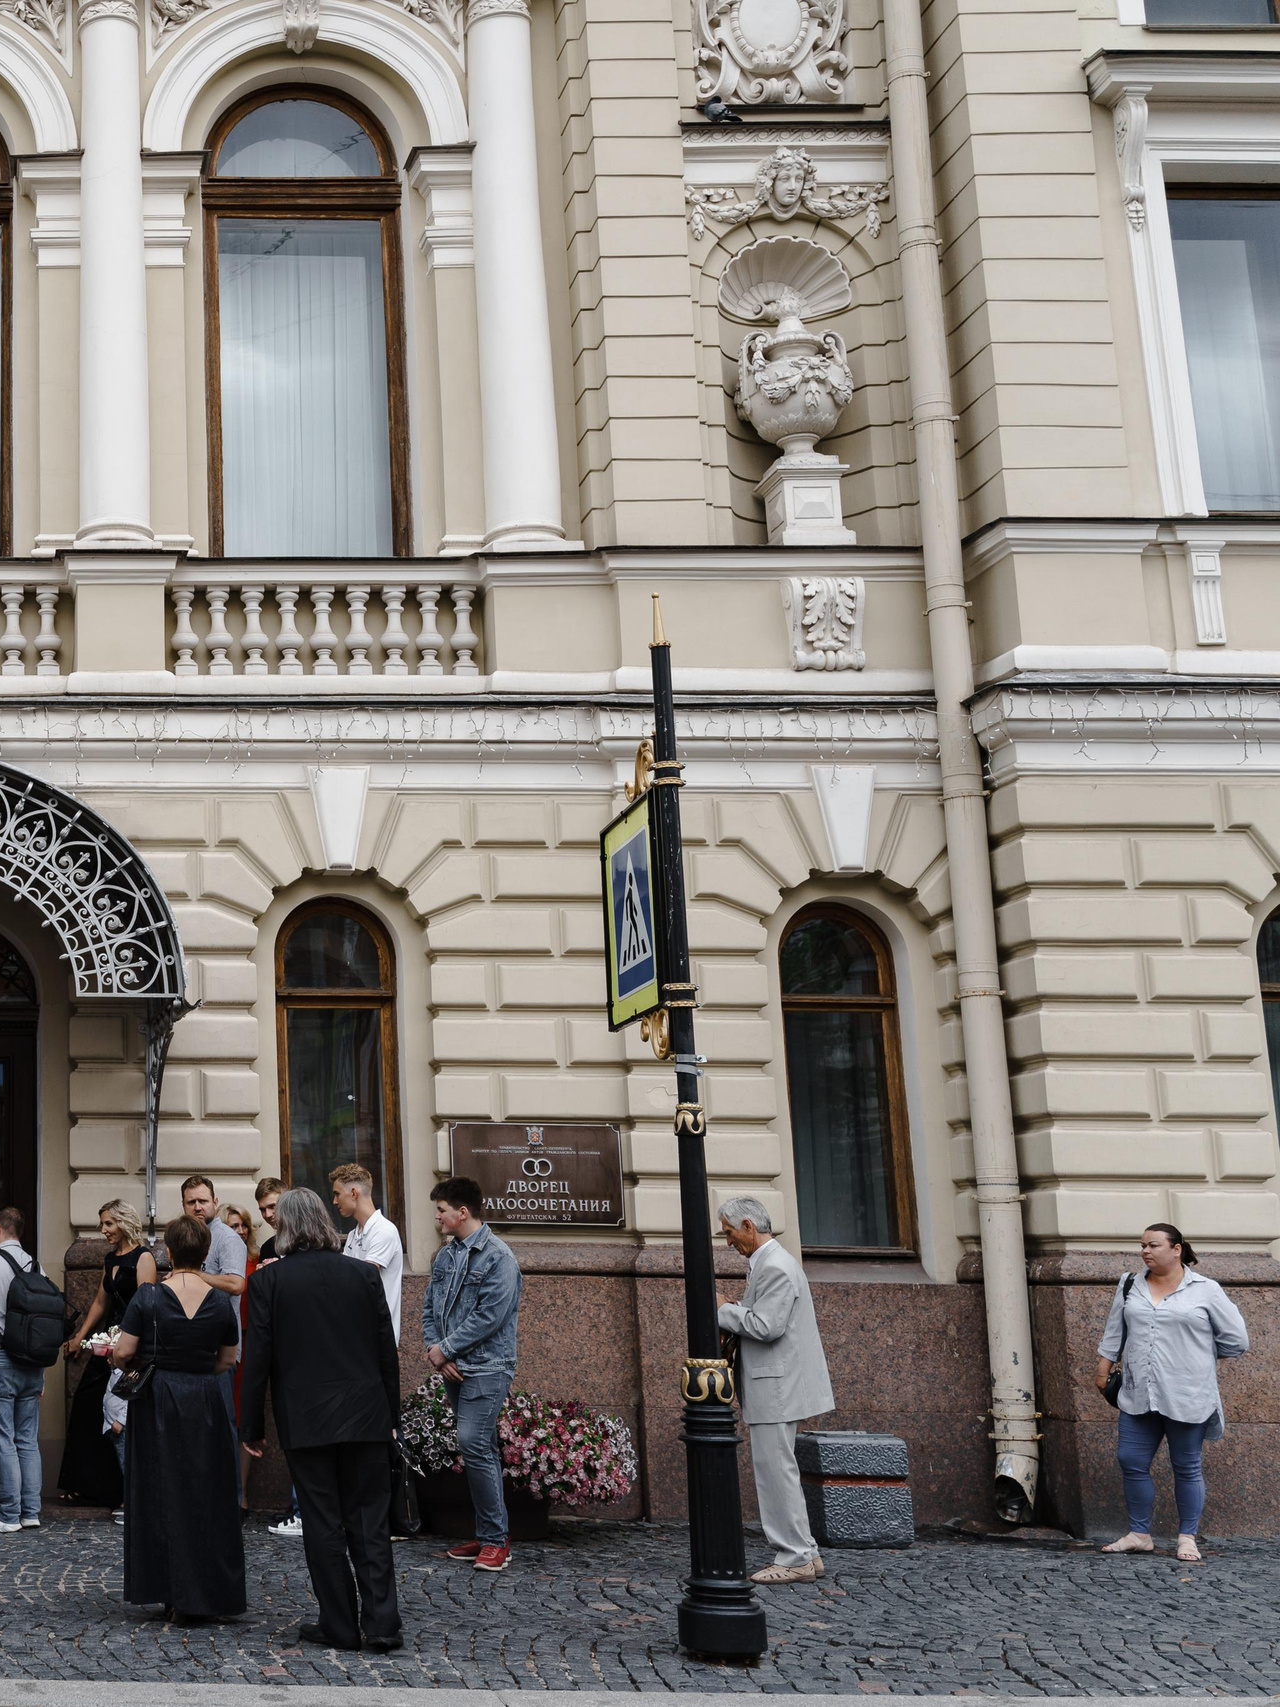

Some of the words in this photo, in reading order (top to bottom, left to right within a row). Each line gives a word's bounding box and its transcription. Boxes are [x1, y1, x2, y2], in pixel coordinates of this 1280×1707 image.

[506, 1180, 570, 1194] ДВОРЕЦ
[482, 1198, 610, 1212] АКОСОЧЕТАНИЯ
[562, 1213, 572, 1221] 52
